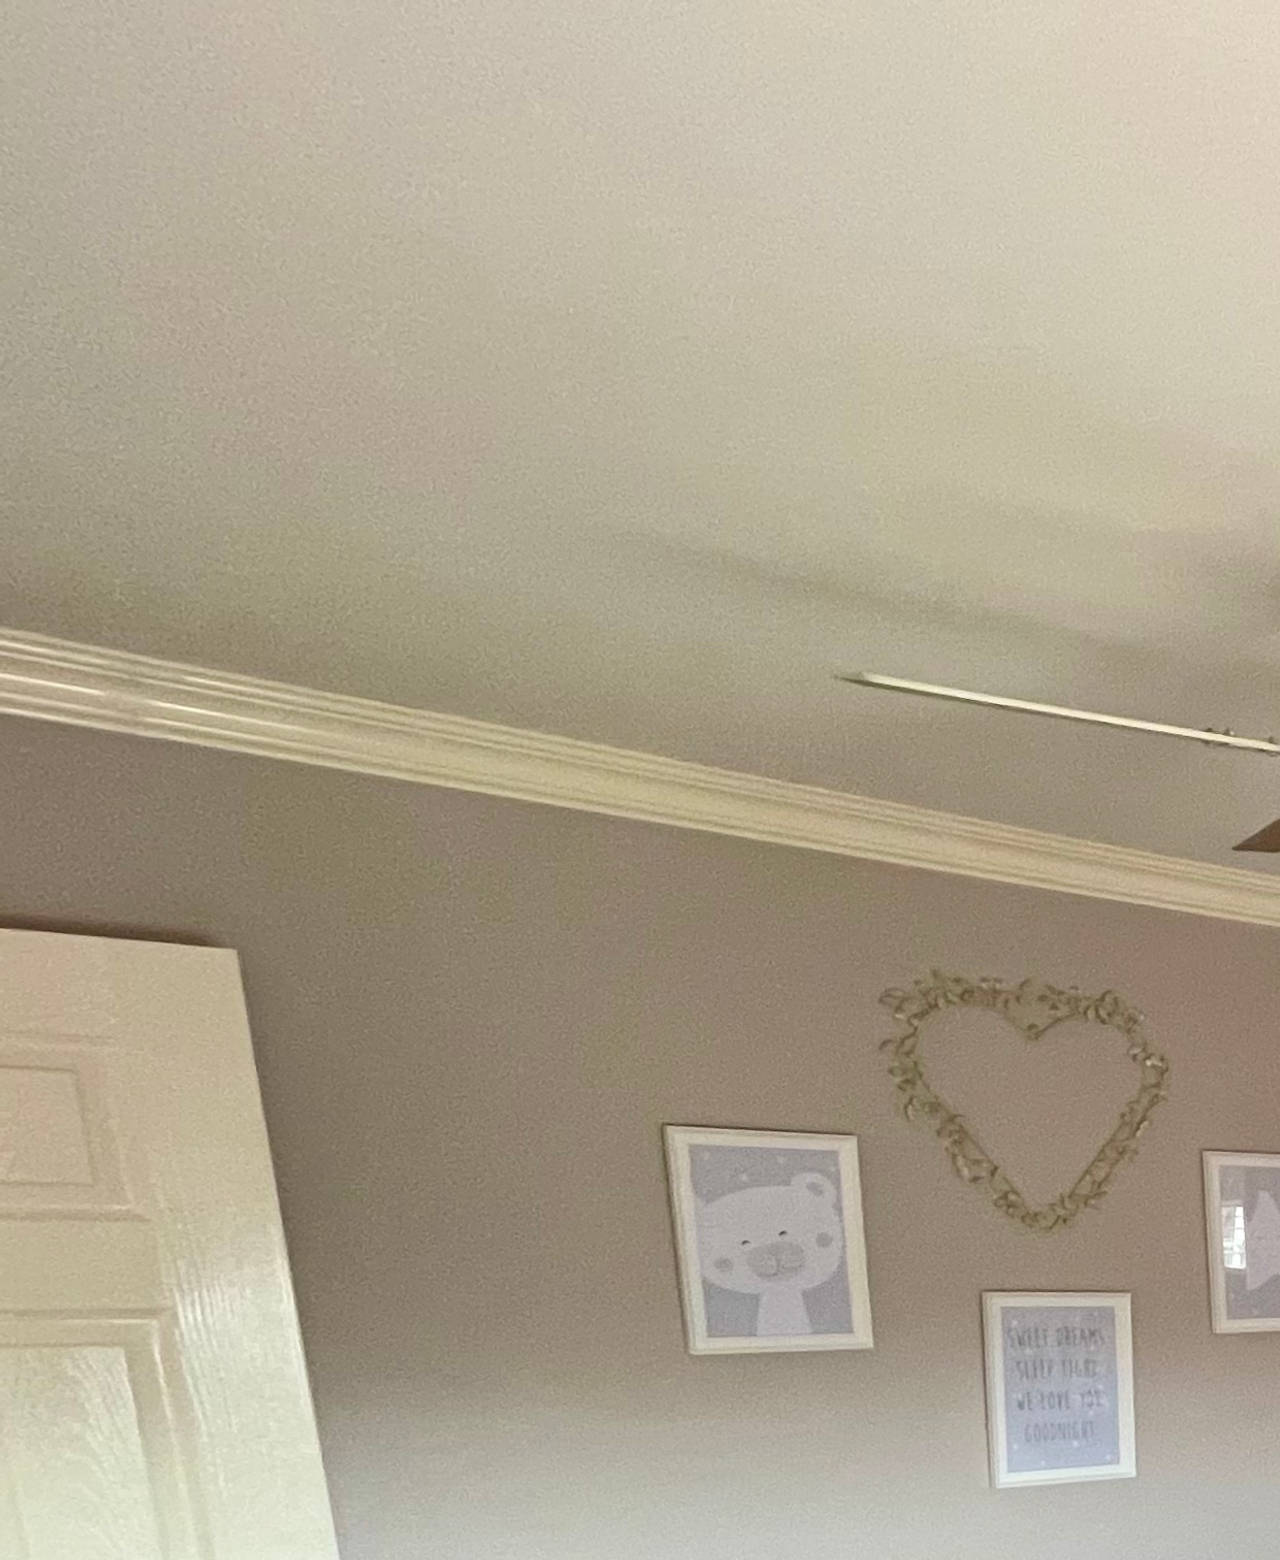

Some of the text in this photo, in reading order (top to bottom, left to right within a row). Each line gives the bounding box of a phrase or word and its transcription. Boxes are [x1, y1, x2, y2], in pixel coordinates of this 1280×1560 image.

[1056, 1326, 1105, 1347] DREAMS
[1041, 1390, 1070, 1411] LOVE
[1024, 1421, 1095, 1443] GOODNIGHT
